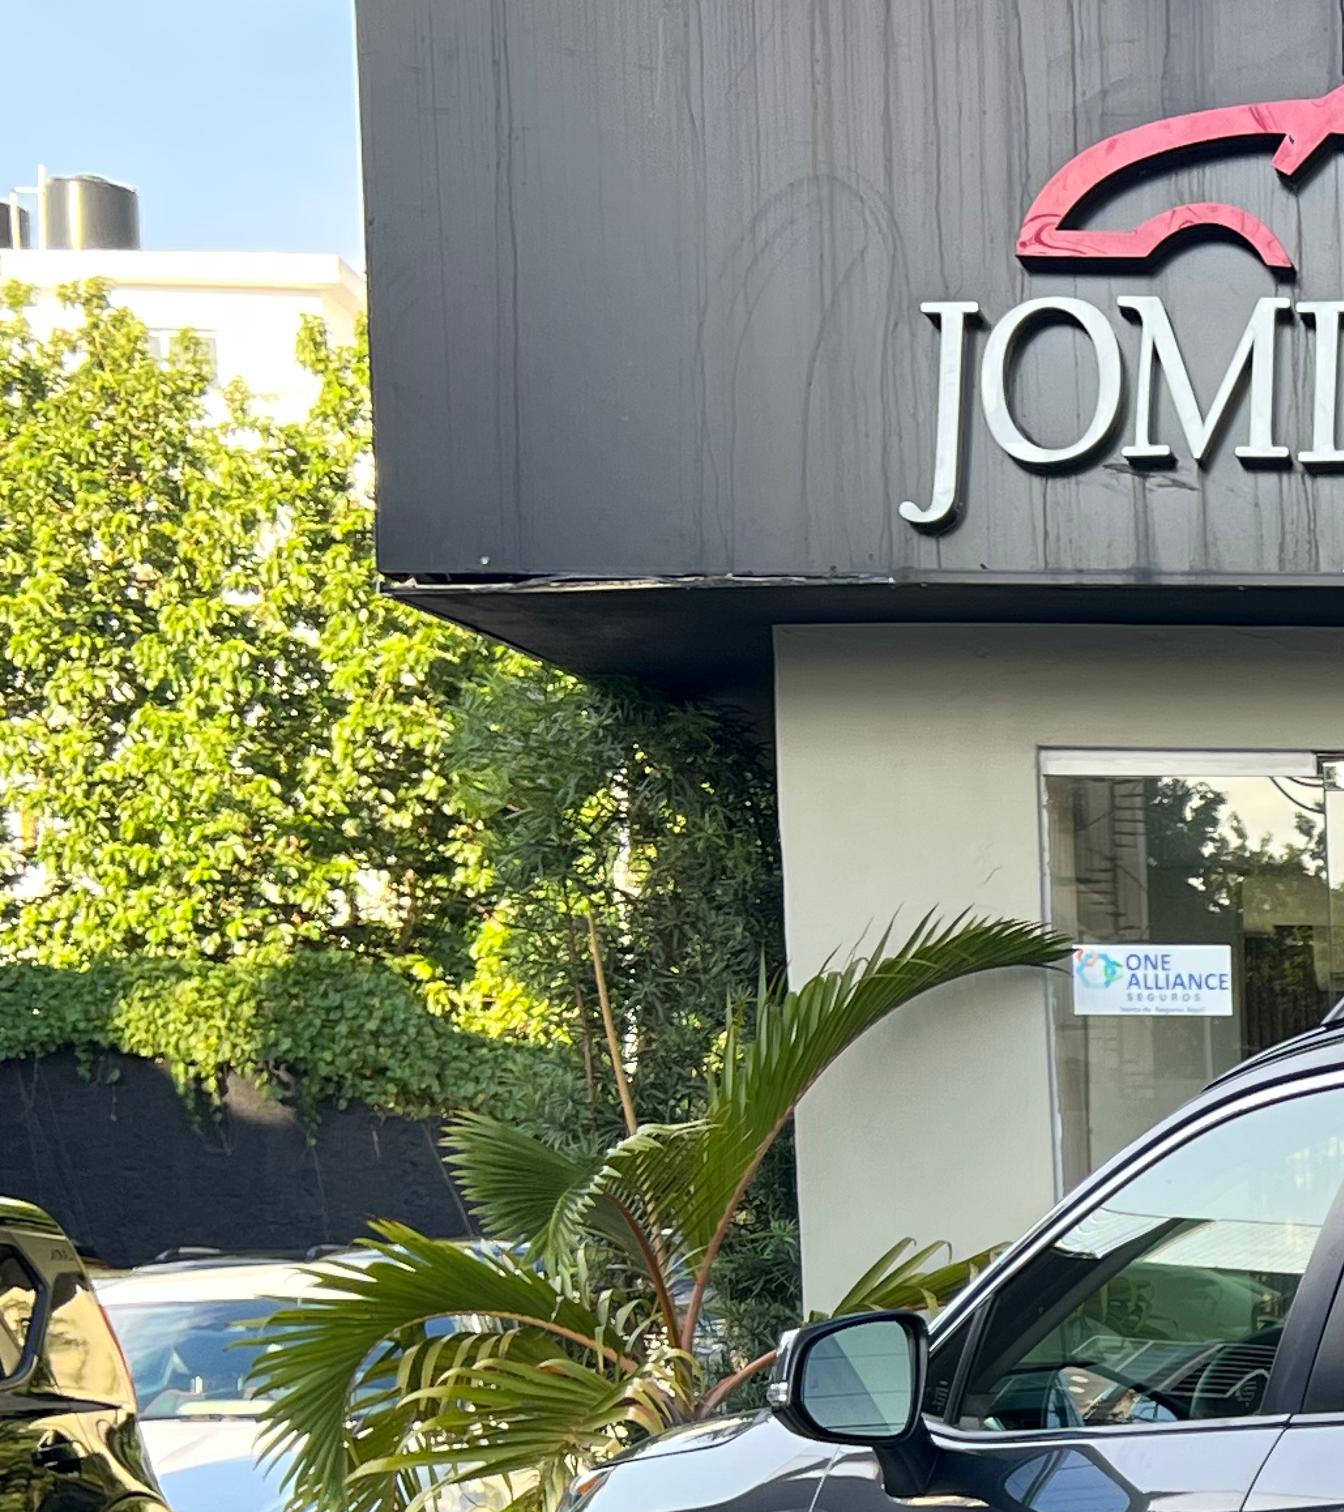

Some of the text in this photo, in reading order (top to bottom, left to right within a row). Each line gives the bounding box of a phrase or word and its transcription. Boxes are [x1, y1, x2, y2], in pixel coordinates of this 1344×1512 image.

[1125, 953, 1172, 972] ONE
[1125, 972, 1230, 991] ALLIANCE
[1126, 992, 1202, 1003] SEGUROS
